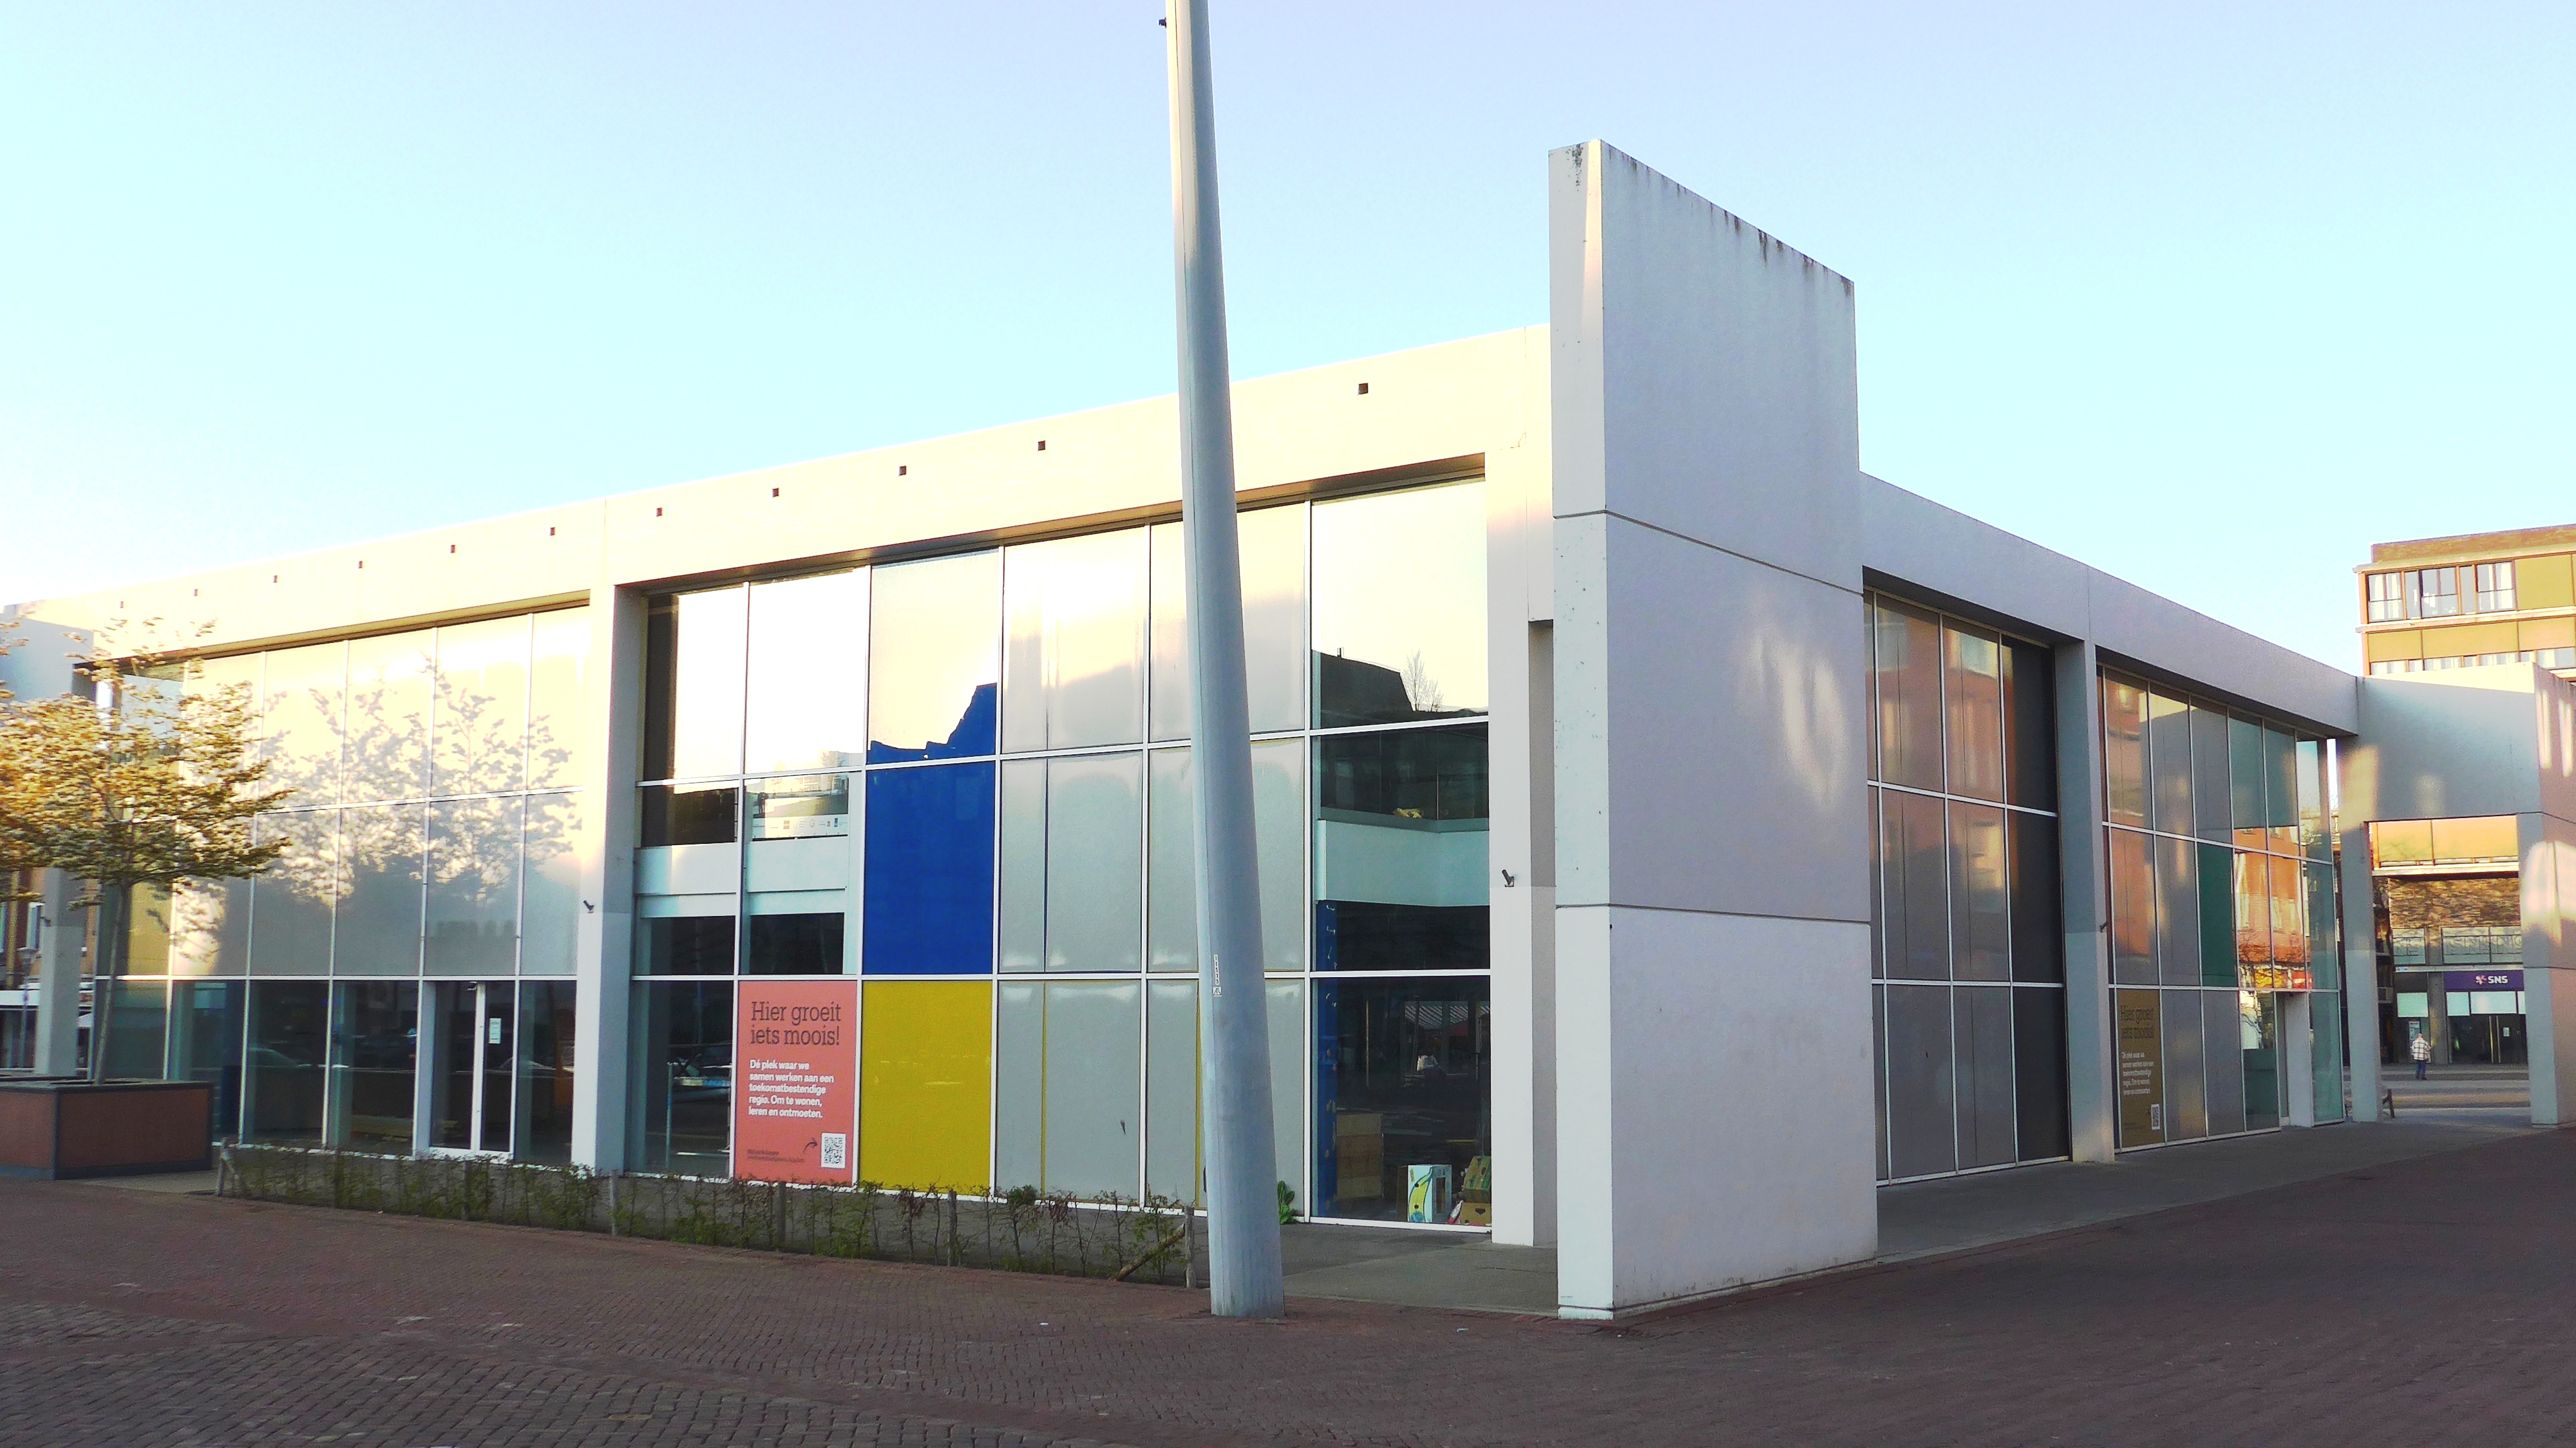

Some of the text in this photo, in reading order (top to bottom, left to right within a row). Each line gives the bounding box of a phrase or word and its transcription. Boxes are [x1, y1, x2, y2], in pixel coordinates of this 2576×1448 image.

[2488, 975, 2508, 984] SNS
[751, 1001, 841, 1025] Hier groeit
[751, 1024, 840, 1045] iets moois!
[750, 1059, 761, 1069] Dé
[761, 1060, 778, 1071] plek
[775, 1072, 802, 1081] werken
[749, 1082, 826, 1096] toekomstbestendige
[749, 1094, 822, 1107] regio. Om te wonen,
[748, 1105, 823, 1118] leren en ontmoeten.
